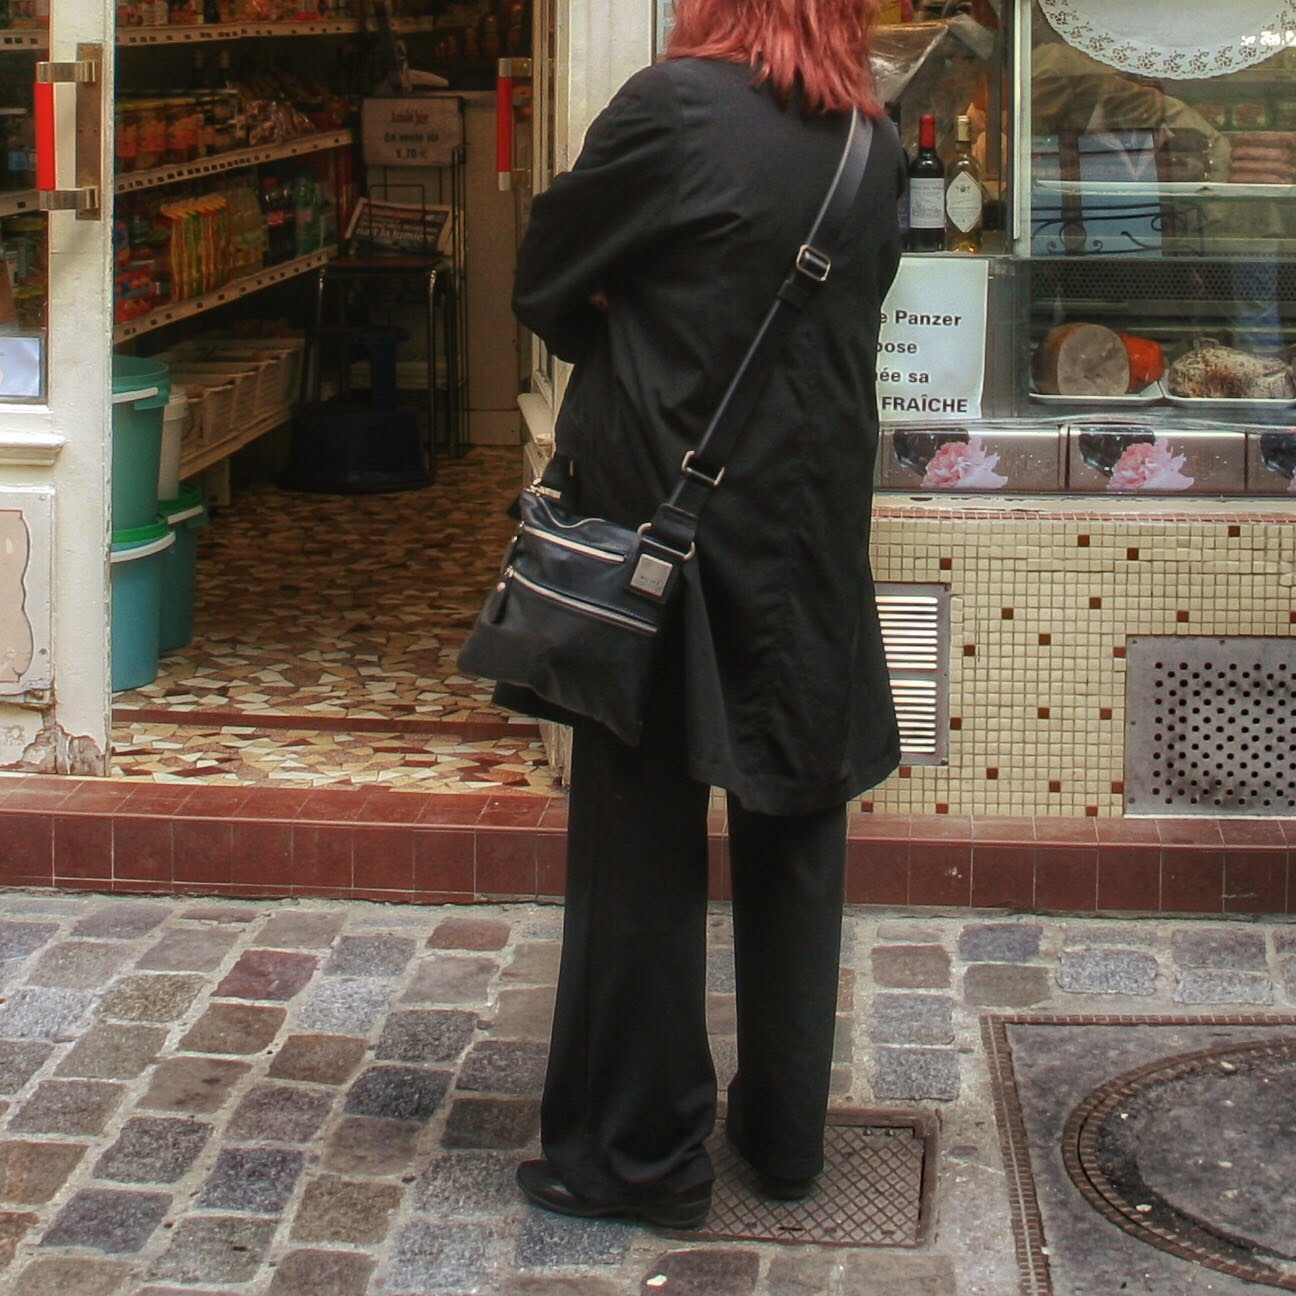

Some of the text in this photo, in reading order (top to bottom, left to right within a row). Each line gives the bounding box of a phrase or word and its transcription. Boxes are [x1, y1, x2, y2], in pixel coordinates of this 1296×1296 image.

[894, 309, 963, 327] Panzer
[876, 366, 930, 384] ée sa
[881, 394, 969, 414] FRAÎCHE
